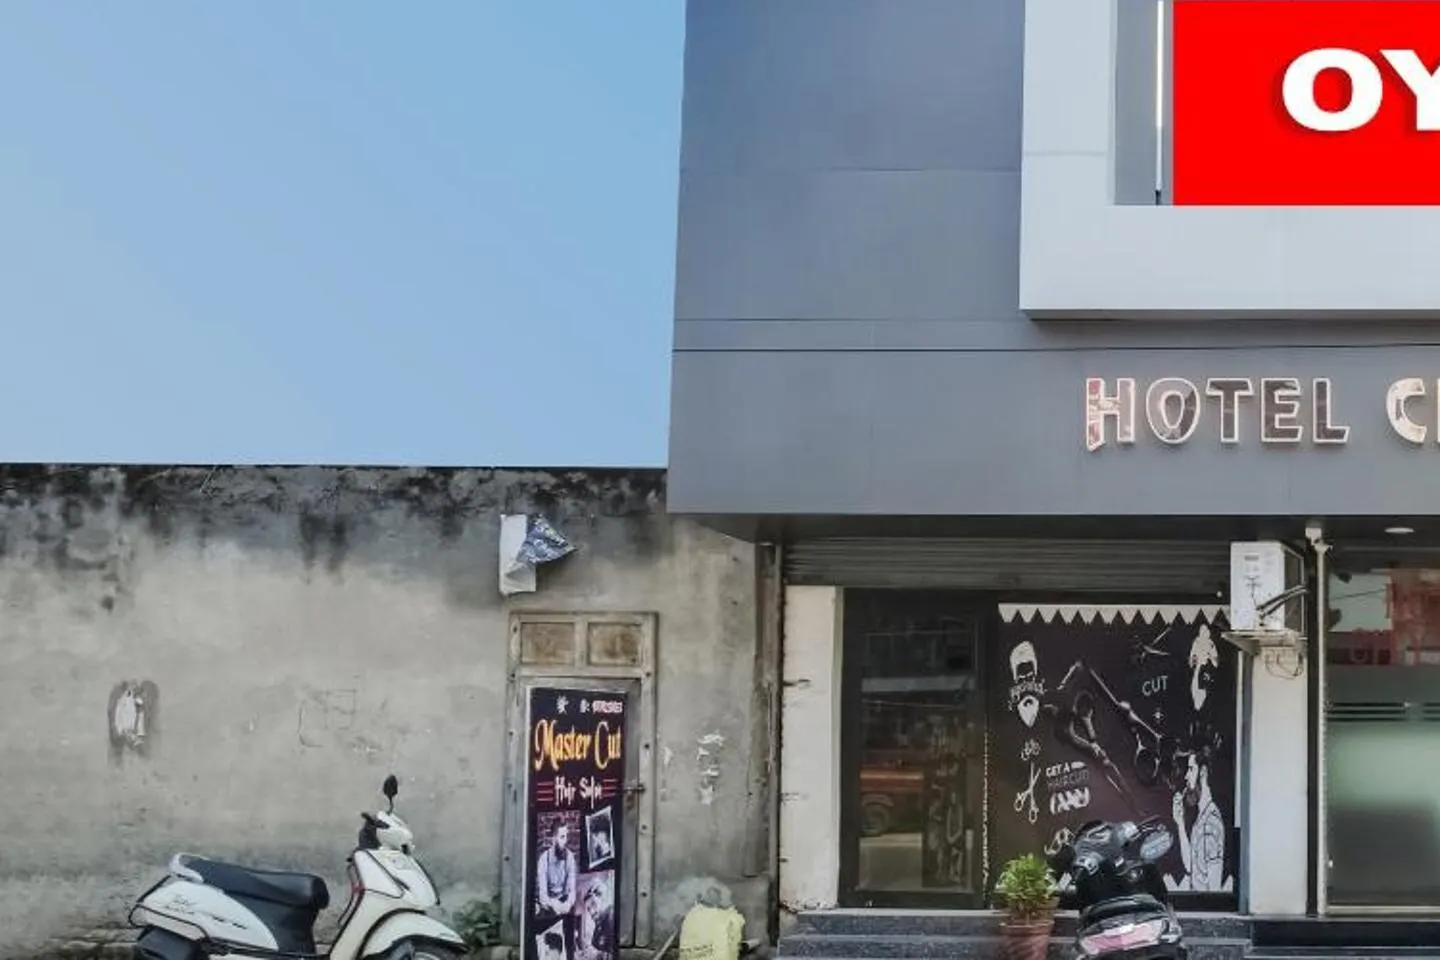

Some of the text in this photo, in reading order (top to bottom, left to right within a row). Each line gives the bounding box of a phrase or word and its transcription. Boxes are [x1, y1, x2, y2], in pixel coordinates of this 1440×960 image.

[1085, 377, 1351, 452] HOTEL
[1142, 675, 1168, 696] CUT
[535, 719, 621, 771] Master Cut
